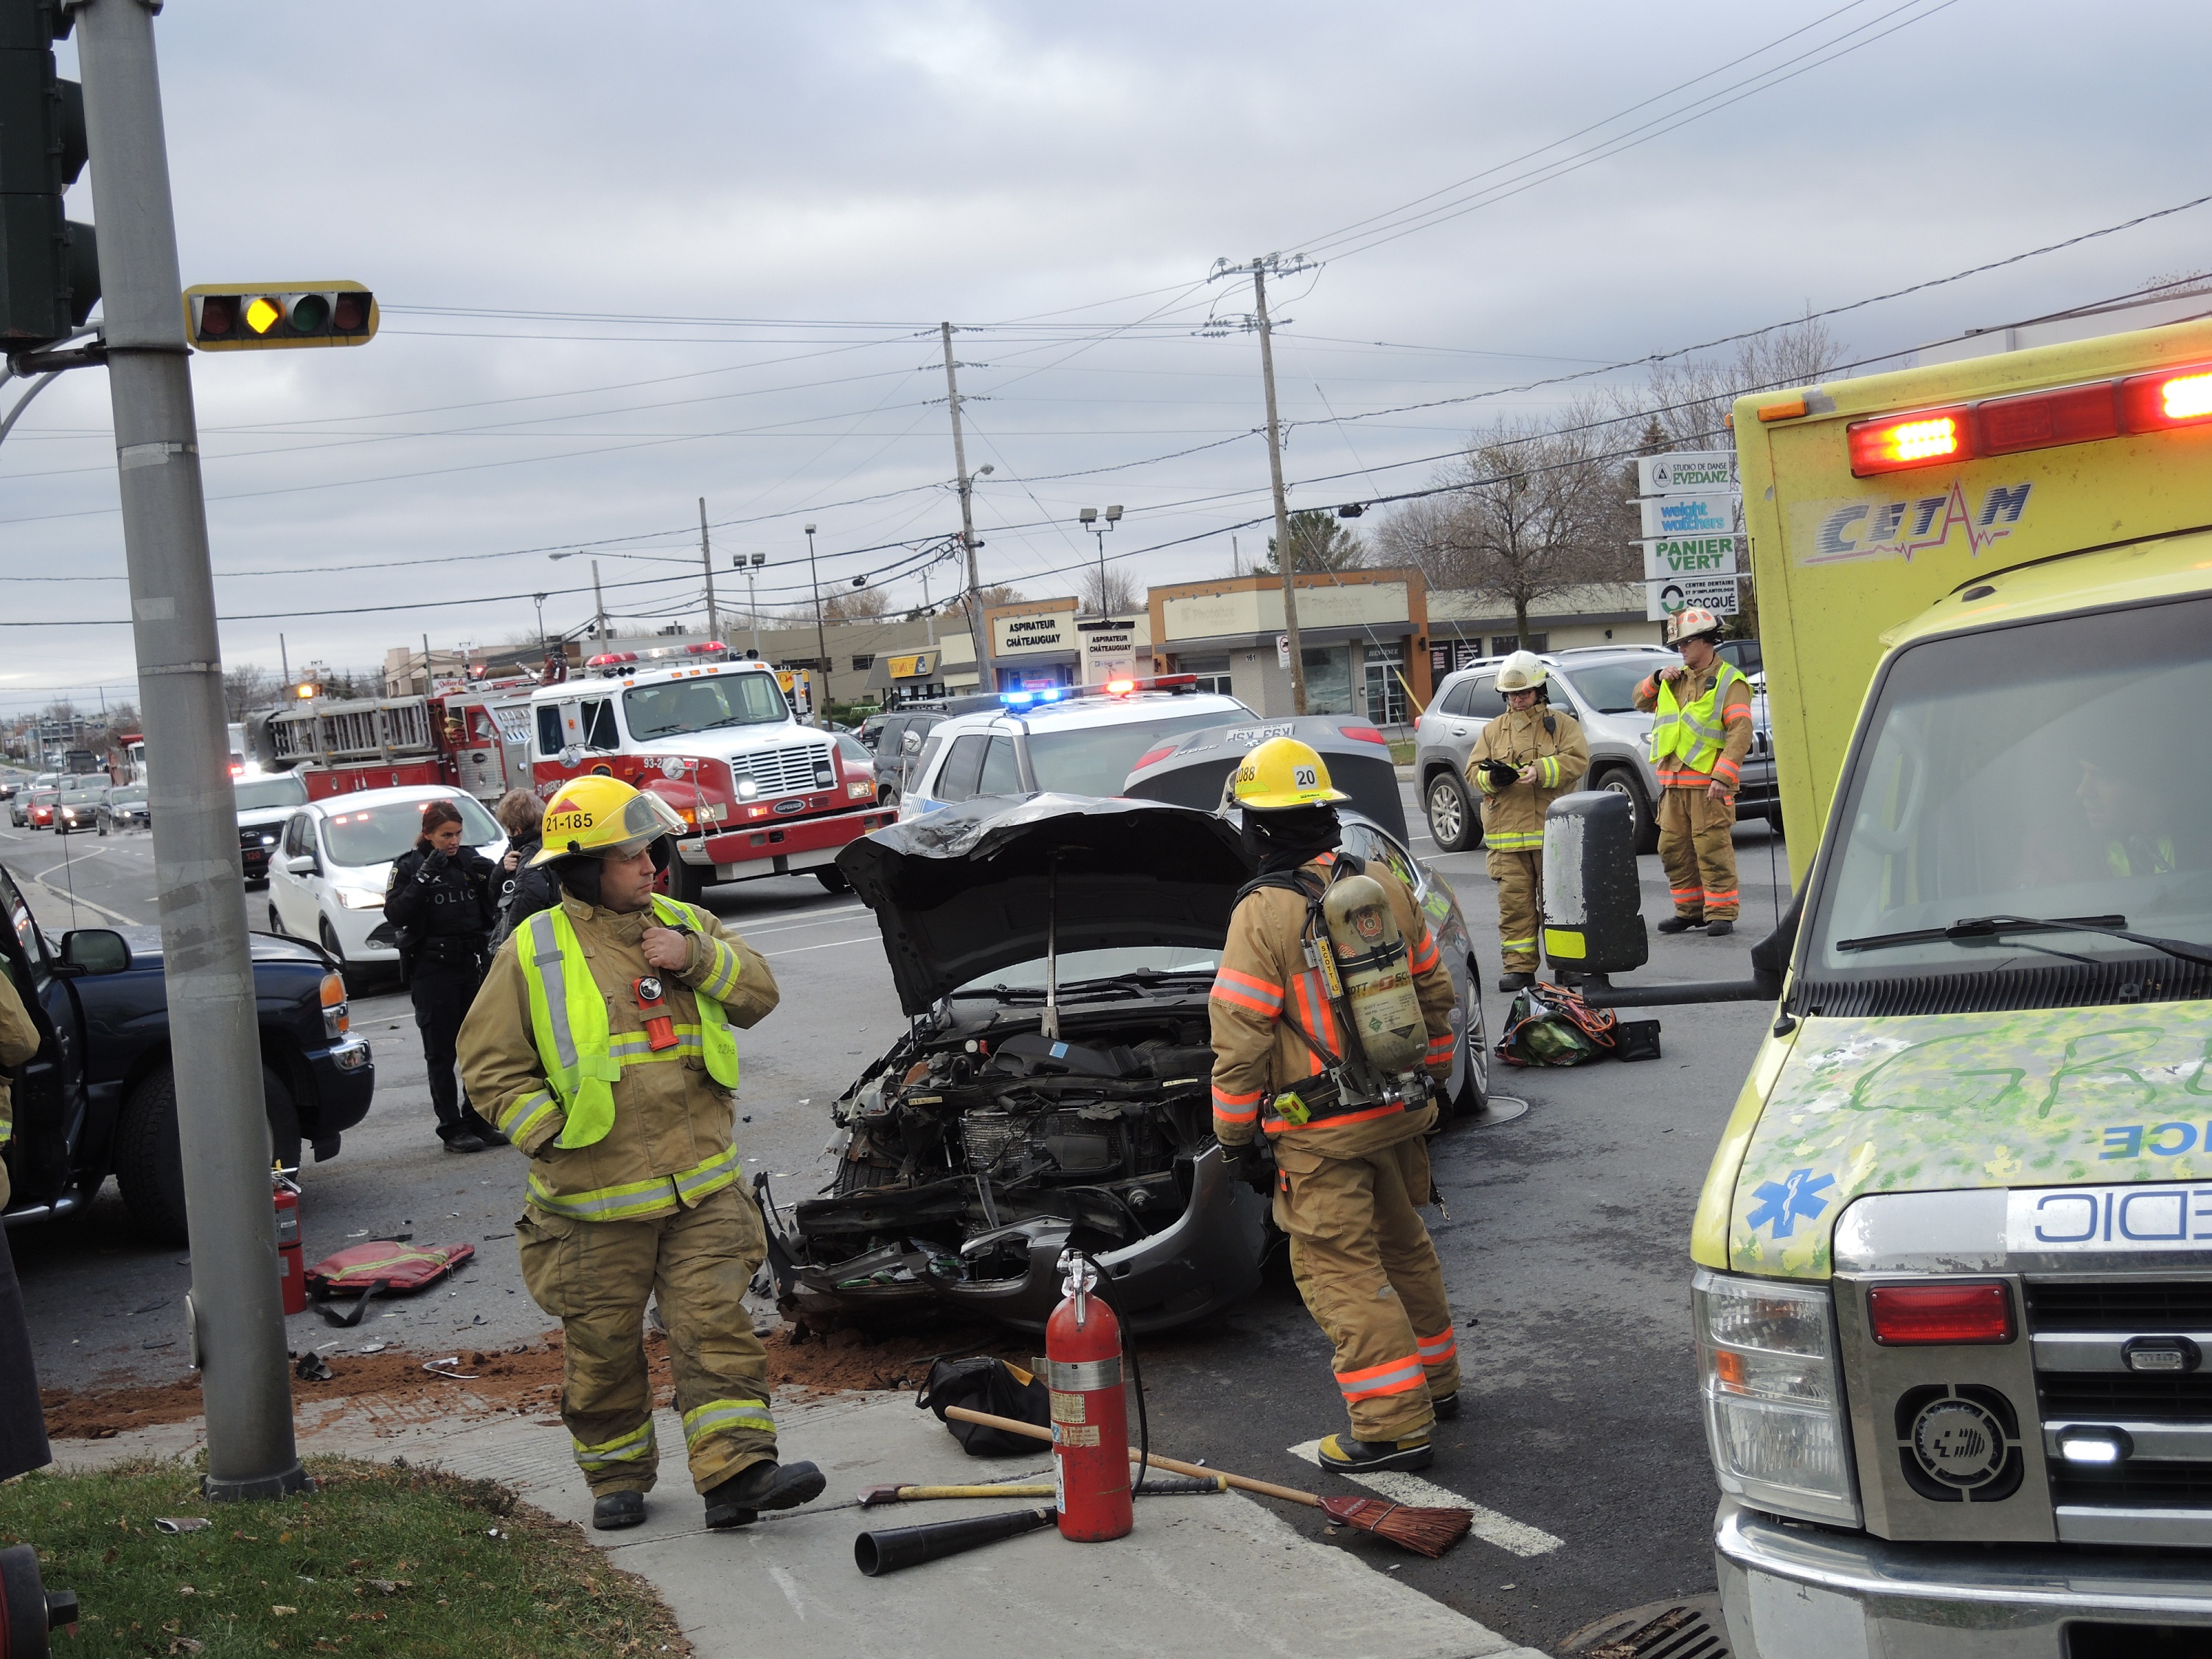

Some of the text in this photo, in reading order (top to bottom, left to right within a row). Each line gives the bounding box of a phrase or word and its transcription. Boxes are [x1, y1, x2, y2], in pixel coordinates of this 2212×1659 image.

[1673, 463, 1696, 471] STUDIO
[1708, 462, 1728, 470] DANSE
[1672, 470, 1728, 484] EVEDANZ
[1660, 501, 1708, 519] weight
[1815, 480, 2032, 554] CETAM
[1661, 516, 1725, 531] watchers
[1656, 538, 1733, 557] PANIER
[1667, 554, 1723, 571] VERT
[1686, 593, 1736, 608] SOCQUÉ
[1009, 619, 1055, 633] ASPIRATEUR
[1006, 633, 1061, 647] CHÂTEAUGUAY
[1092, 635, 1127, 643] ASPIRATEUR
[1090, 644, 1132, 653] CHÂTEAUGUAY
[644, 757, 666, 768] 93-2
[1296, 770, 1315, 786] 20
[546, 813, 593, 832] 21-185
[426, 889, 478, 905] OLIC
[1321, 946, 1333, 978] SCOTT
